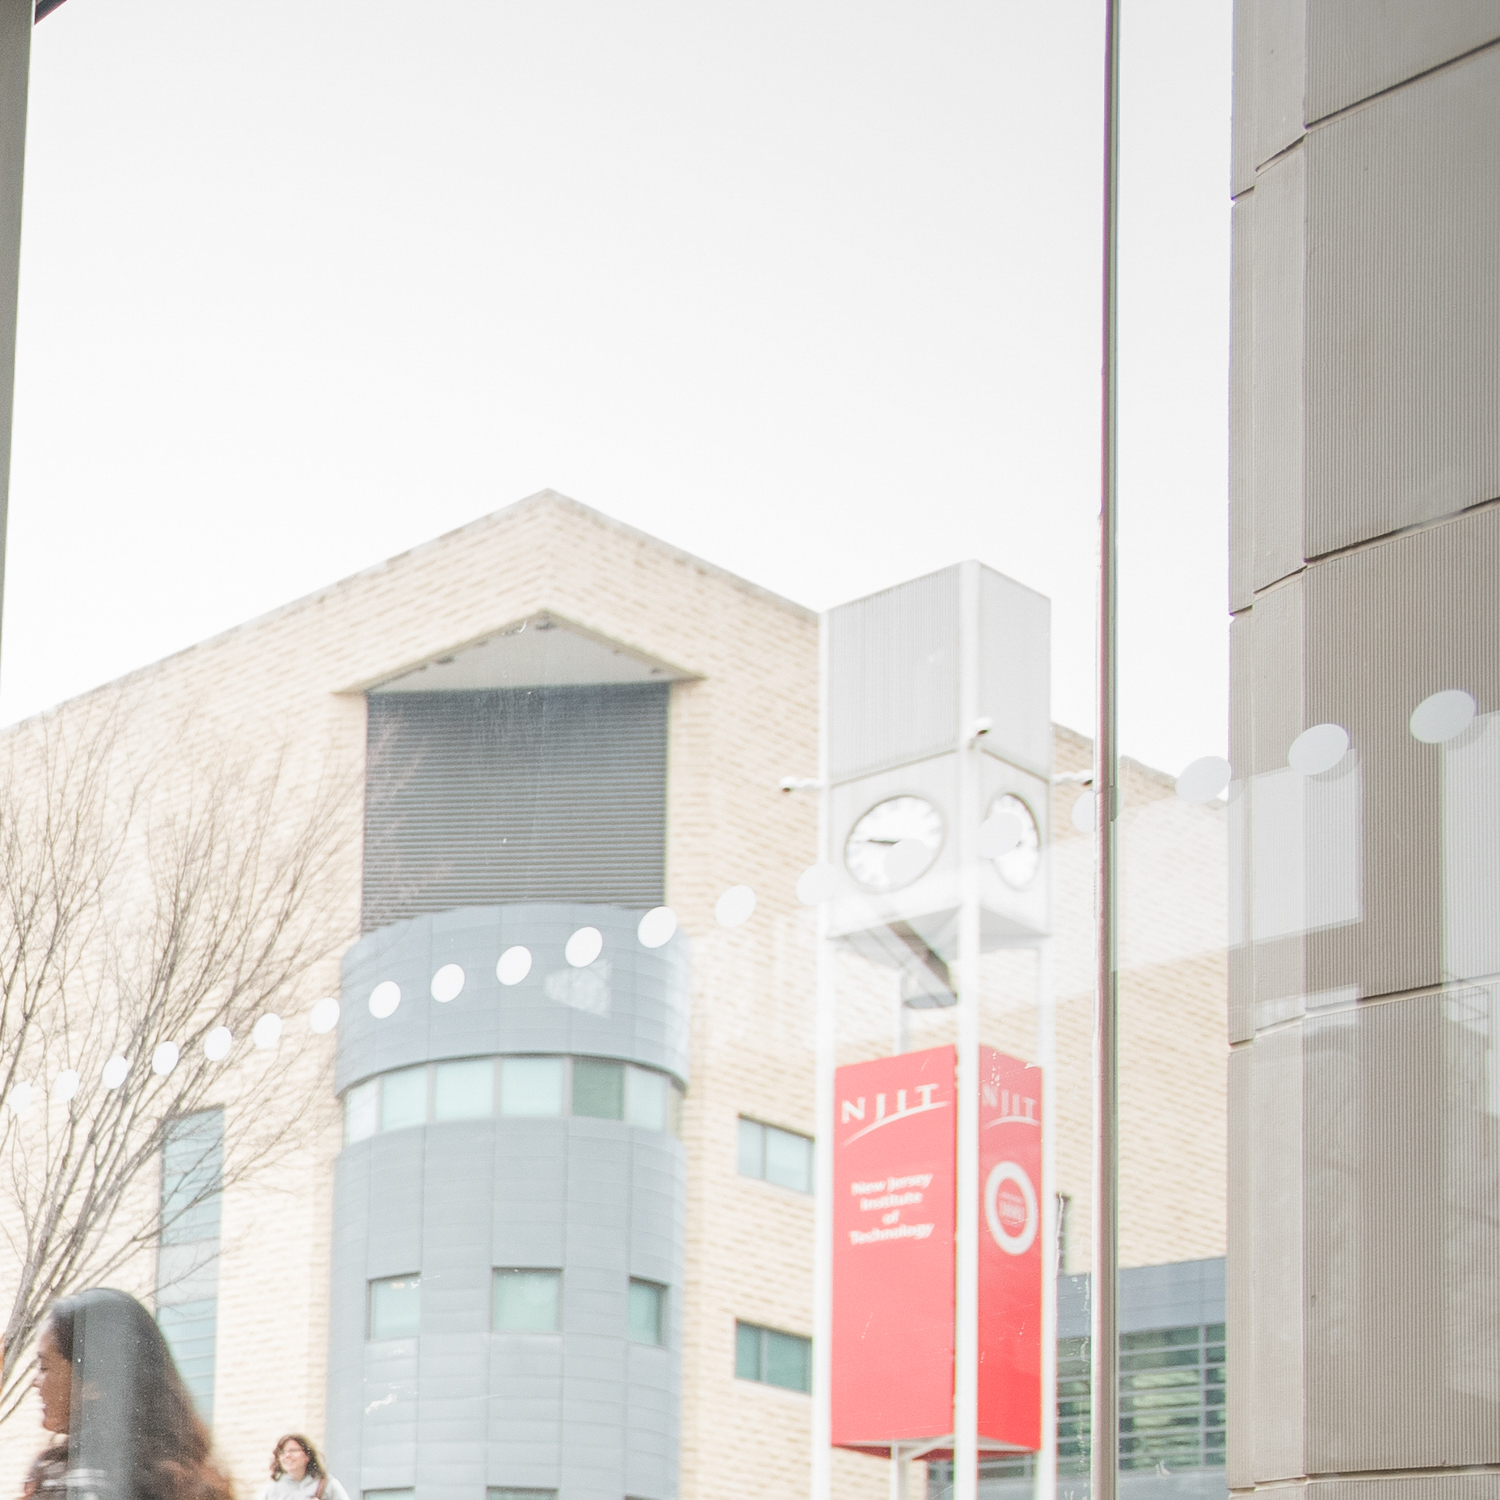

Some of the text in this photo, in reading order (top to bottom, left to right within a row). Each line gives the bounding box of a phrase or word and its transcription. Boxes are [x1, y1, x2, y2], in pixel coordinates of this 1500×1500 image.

[841, 1083, 940, 1124] NJIT
[981, 1083, 1037, 1119] NJIT
[850, 1173, 934, 1196] New Jersey
[860, 1191, 923, 1211] Institute
[882, 1209, 900, 1225] of
[849, 1223, 935, 1245] Technology
